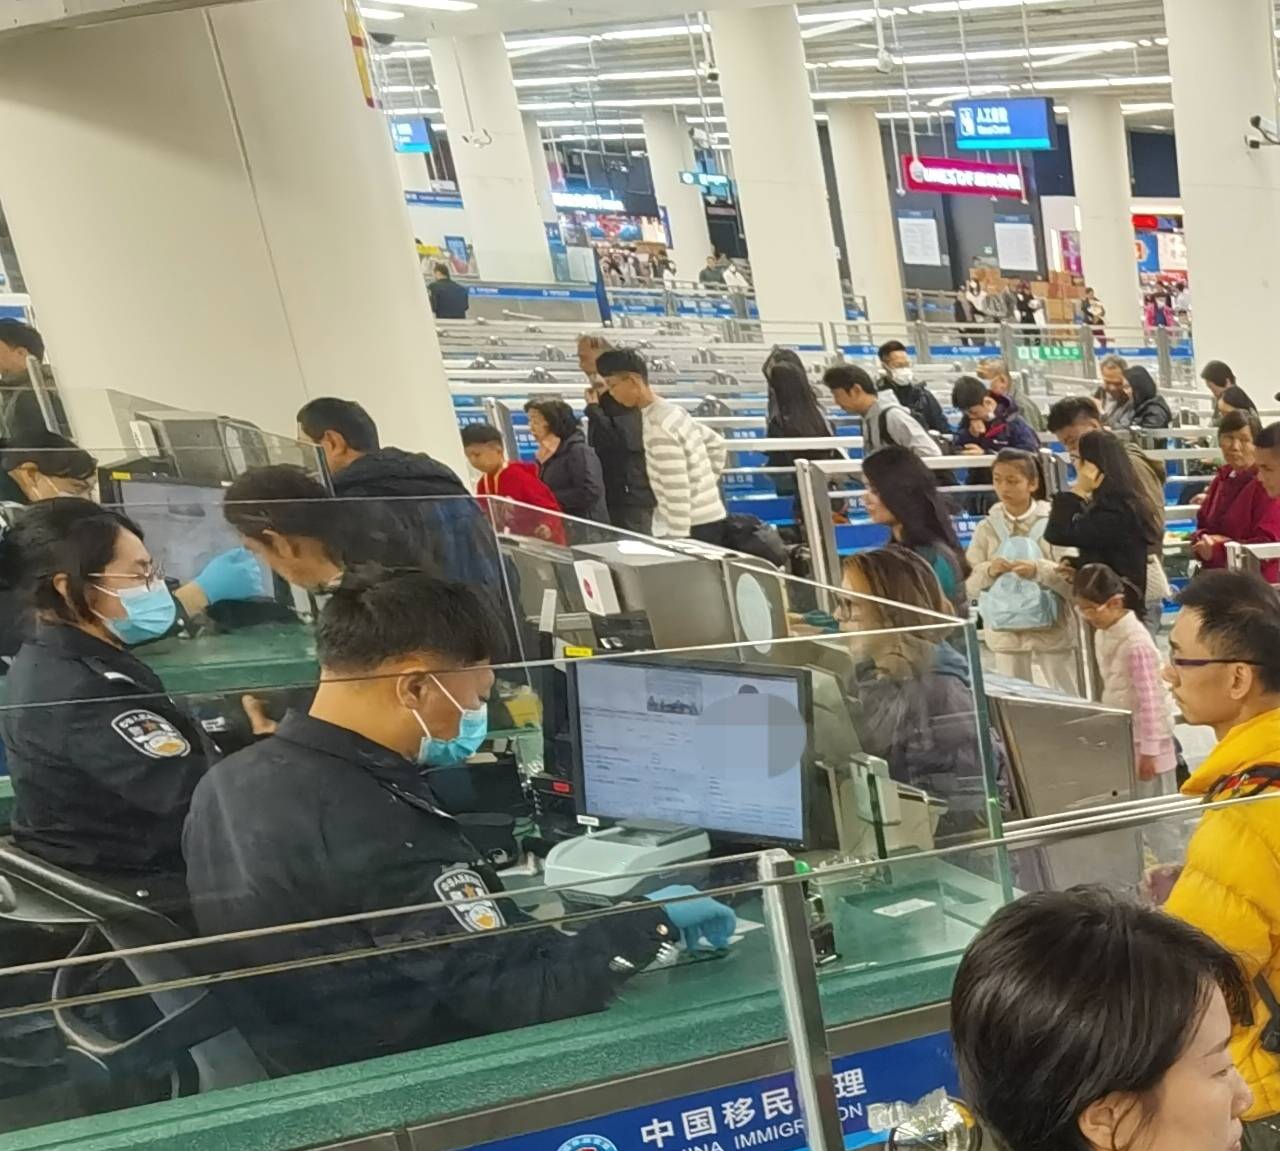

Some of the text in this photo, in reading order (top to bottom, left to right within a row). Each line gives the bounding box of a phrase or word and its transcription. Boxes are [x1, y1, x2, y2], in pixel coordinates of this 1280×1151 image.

[640, 1067, 868, 1149] 中国移民理
